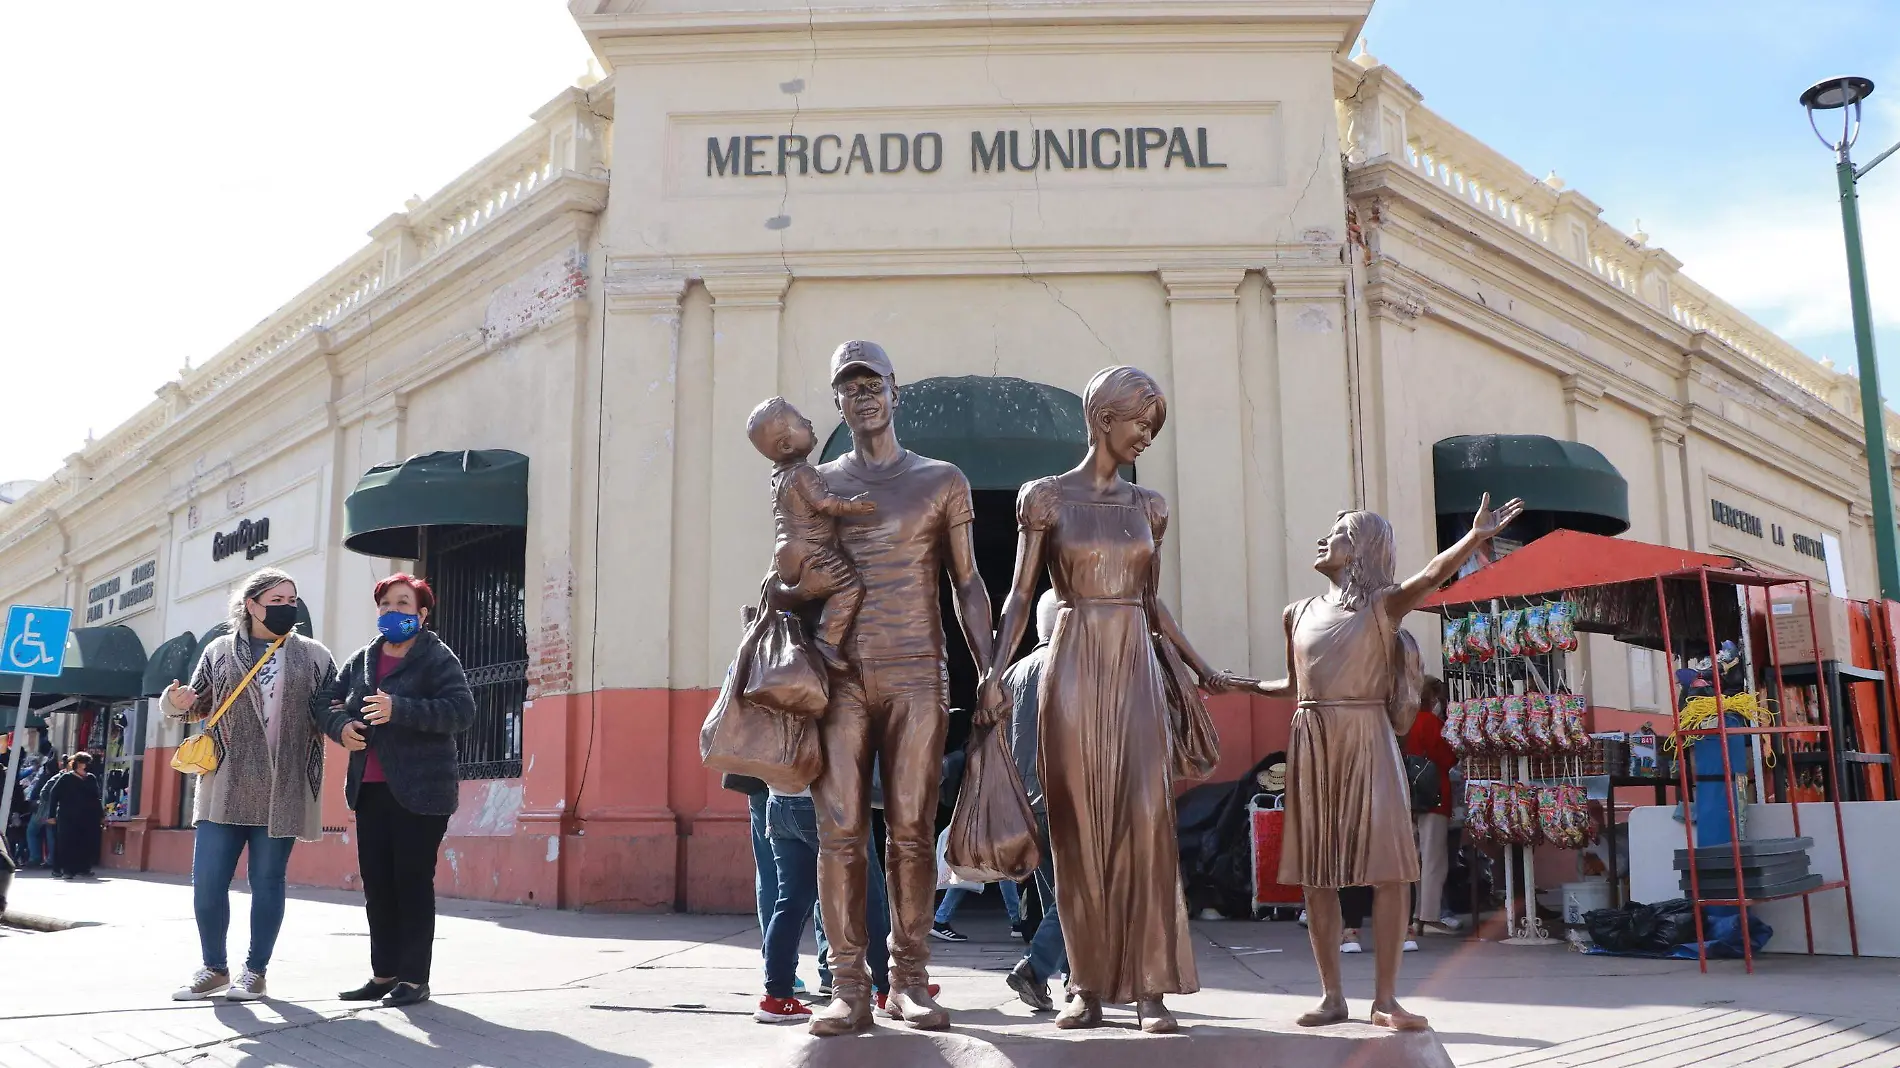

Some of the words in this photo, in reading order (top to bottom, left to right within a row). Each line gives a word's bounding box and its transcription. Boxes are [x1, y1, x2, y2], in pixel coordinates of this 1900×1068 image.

[707, 132, 943, 177] MERCADO
[971, 127, 1228, 171] MUNICIPAL
[1711, 499, 1763, 538] MERCERIA
[1771, 523, 1785, 546] LA
[1793, 533, 1826, 561] SURTID
[132, 560, 155, 585] FLORES
[109, 598, 114, 614] Y
